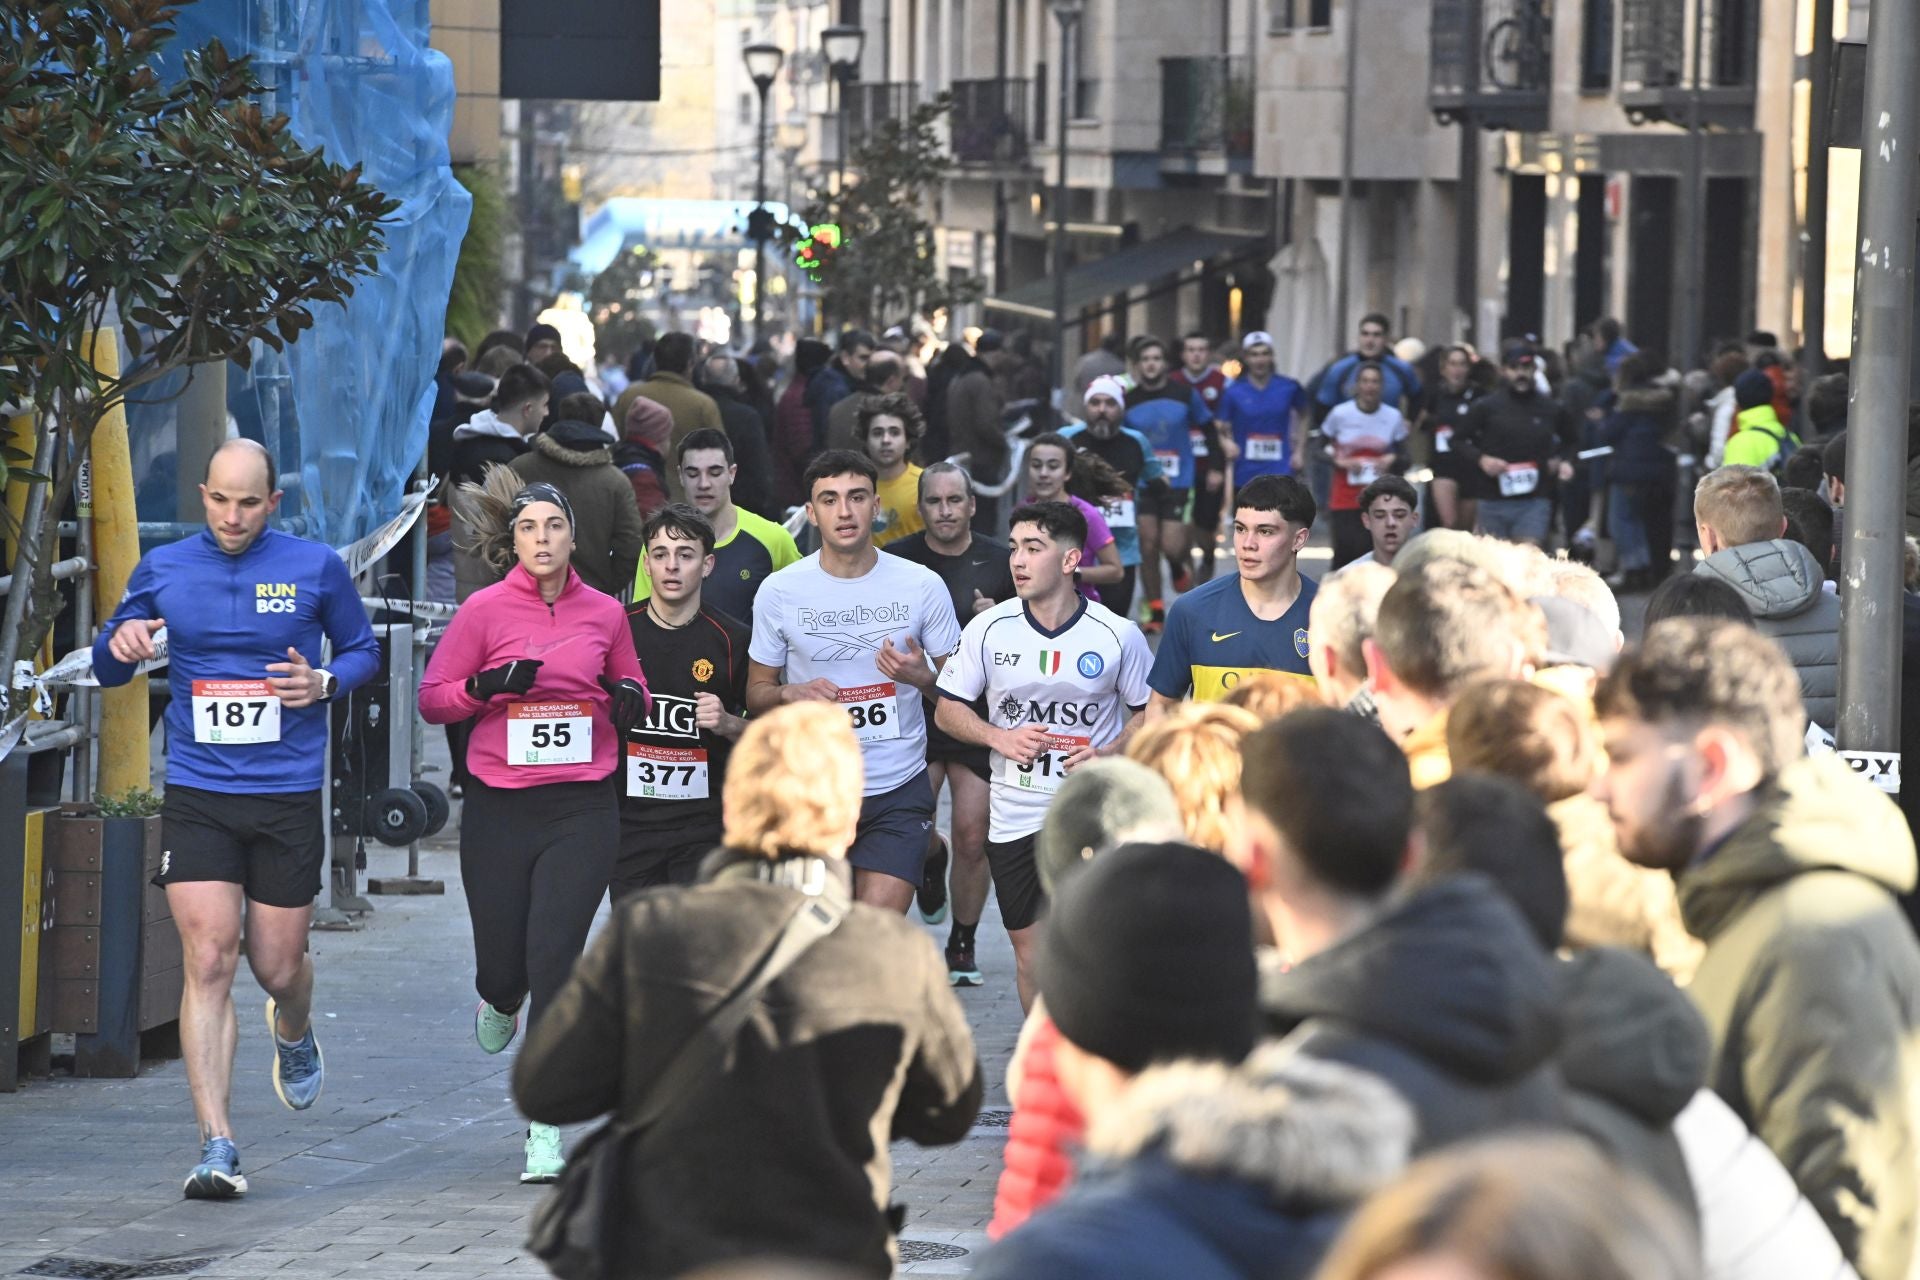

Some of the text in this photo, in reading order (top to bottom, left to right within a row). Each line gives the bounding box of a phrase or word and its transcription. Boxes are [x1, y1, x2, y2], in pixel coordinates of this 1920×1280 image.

[81, 462, 89, 488] ULMA
[255, 583, 296, 597] RUN
[256, 598, 297, 613] BOS
[797, 601, 910, 631] Reebok
[994, 652, 1021, 666] EA7
[1084, 658, 1097, 672] N
[206, 702, 267, 728] 187
[1028, 700, 1099, 727] MSC
[531, 722, 571, 749] 55
[638, 761, 696, 786] 377
